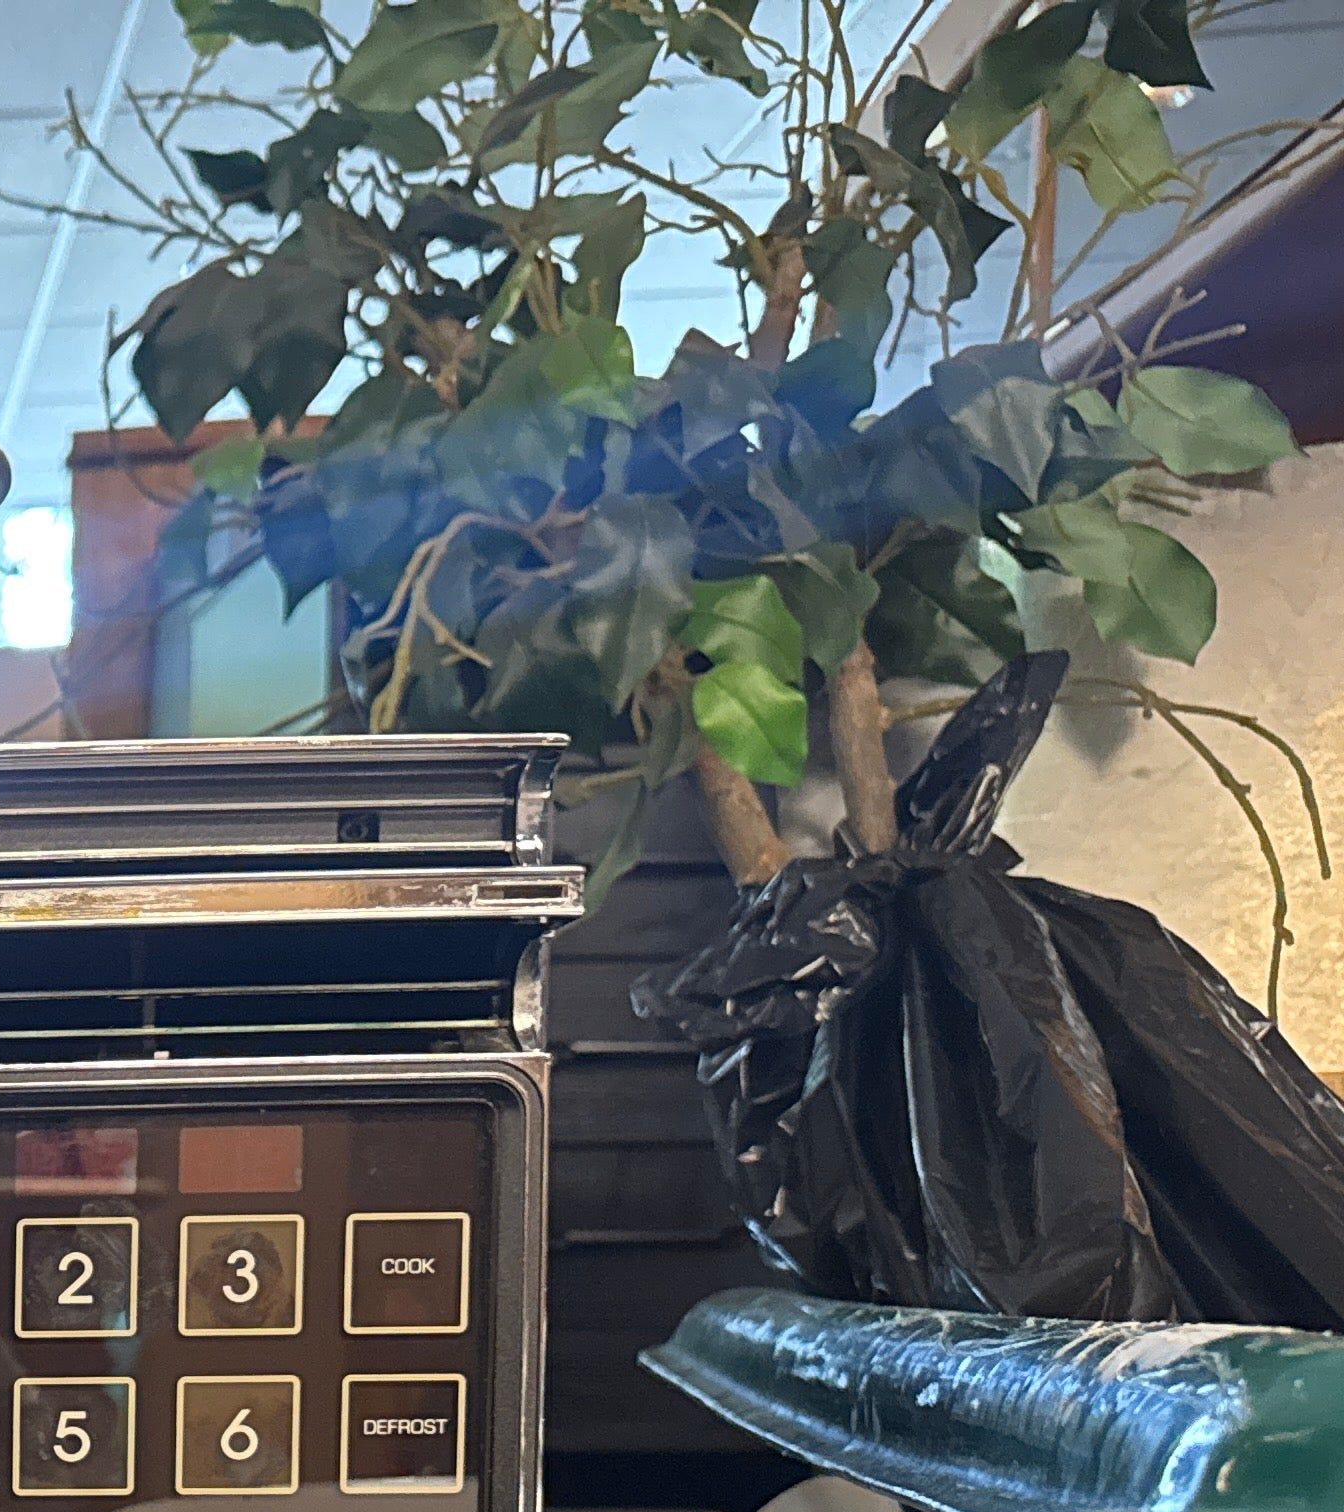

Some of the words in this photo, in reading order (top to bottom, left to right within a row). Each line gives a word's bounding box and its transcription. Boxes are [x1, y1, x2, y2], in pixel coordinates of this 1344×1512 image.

[57, 1251, 94, 1305] 2
[222, 1249, 259, 1303] 3
[381, 1257, 435, 1275] COOK
[53, 1410, 91, 1463] 5
[220, 1408, 259, 1461] 6
[363, 1418, 448, 1435] DEFROST
